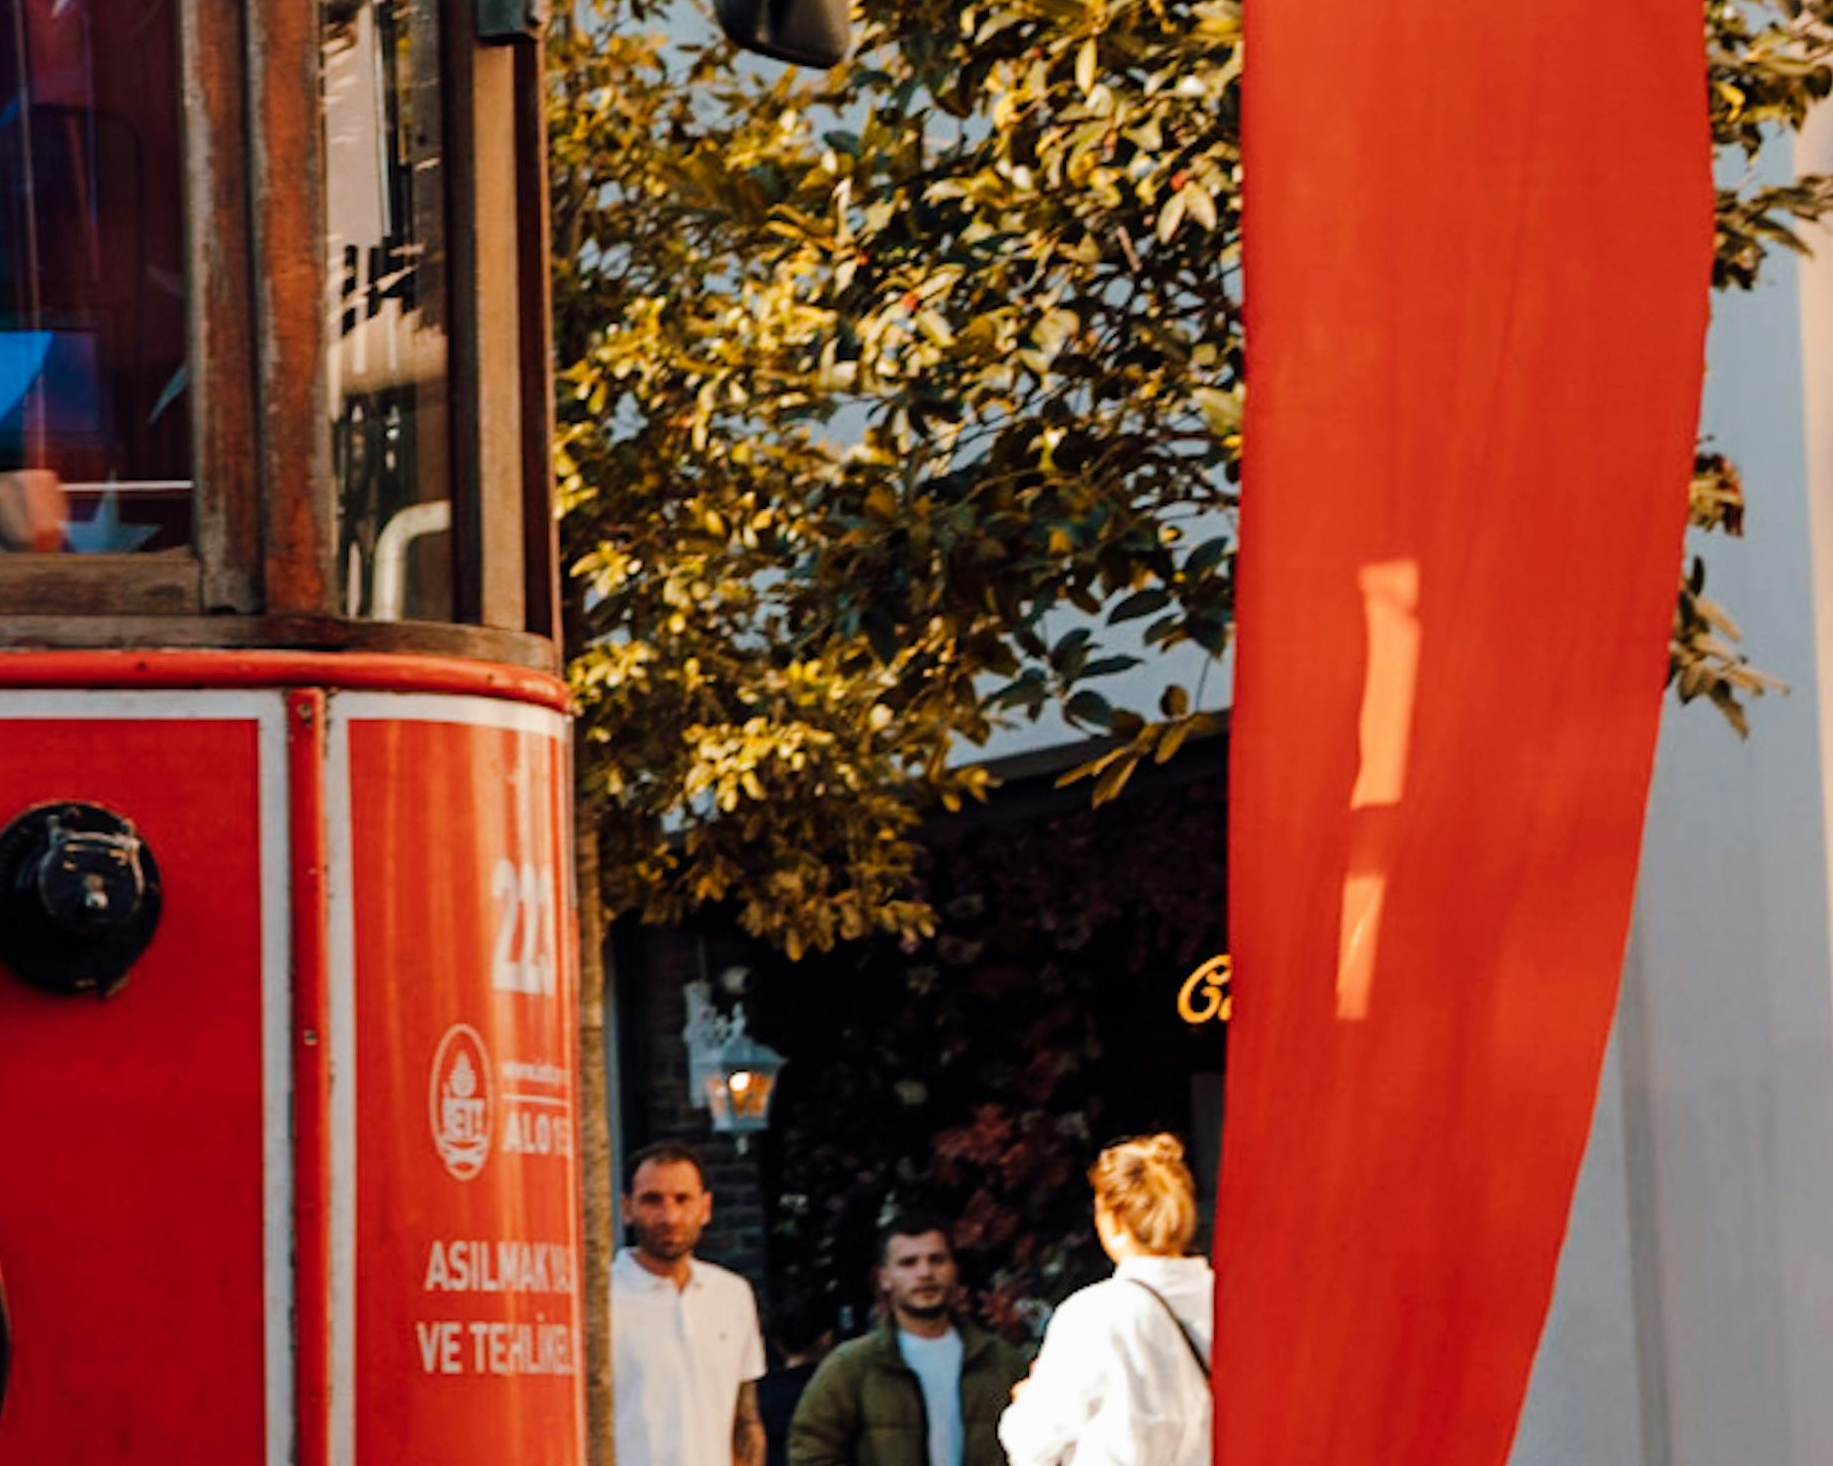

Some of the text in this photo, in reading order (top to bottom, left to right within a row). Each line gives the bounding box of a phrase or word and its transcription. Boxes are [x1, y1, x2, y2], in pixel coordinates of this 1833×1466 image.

[501, 1109, 550, 1155] ALO
[423, 1240, 549, 1292] ASILMAK
[416, 1321, 462, 1374] VE
